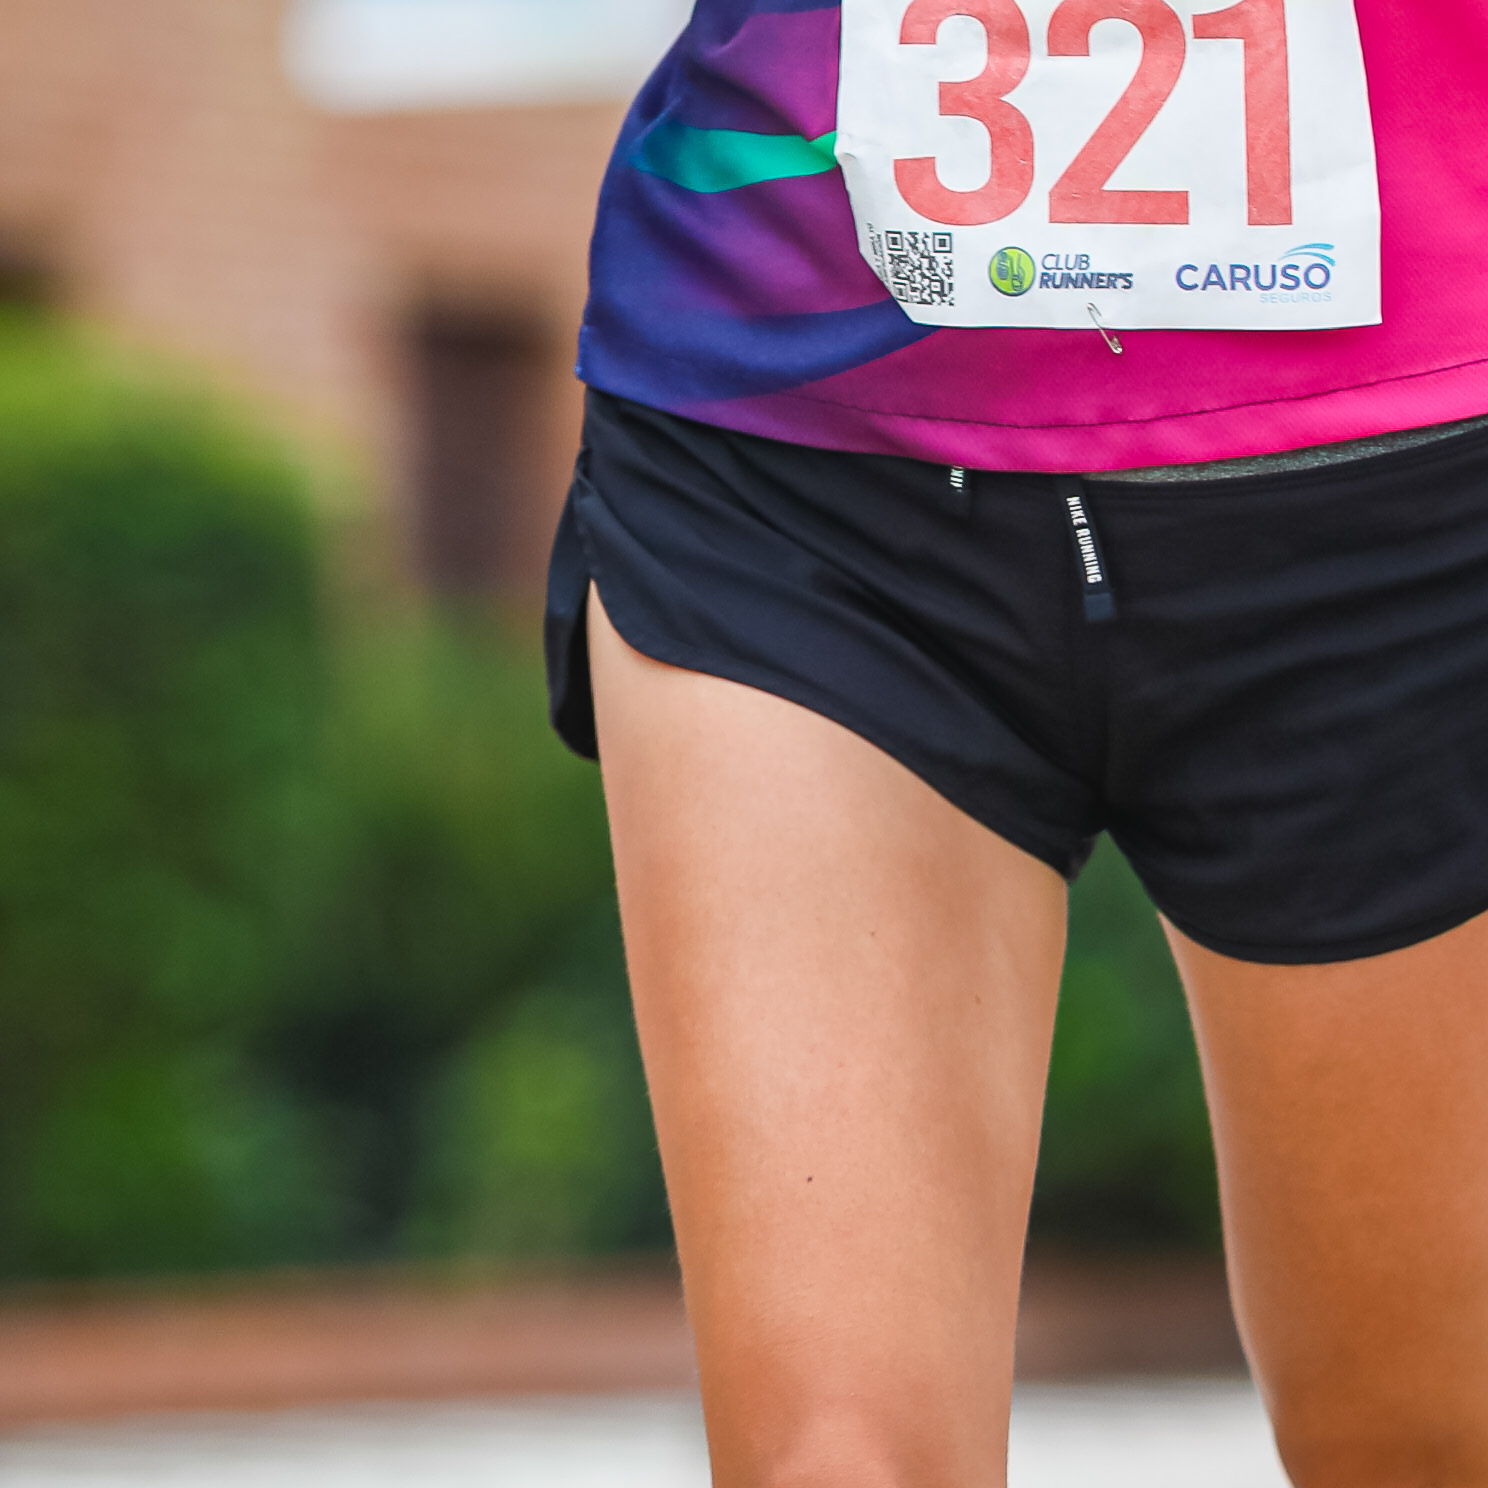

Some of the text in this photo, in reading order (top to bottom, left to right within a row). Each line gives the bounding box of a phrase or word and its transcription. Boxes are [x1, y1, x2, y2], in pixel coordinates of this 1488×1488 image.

[1040, 253, 1091, 270] CLUB
[1038, 272, 1134, 289] RUNNER'S
[1175, 263, 1331, 291] CARUSO
[1259, 291, 1333, 304] SEGUROS
[1066, 496, 1103, 584] NIKE RUNNING
